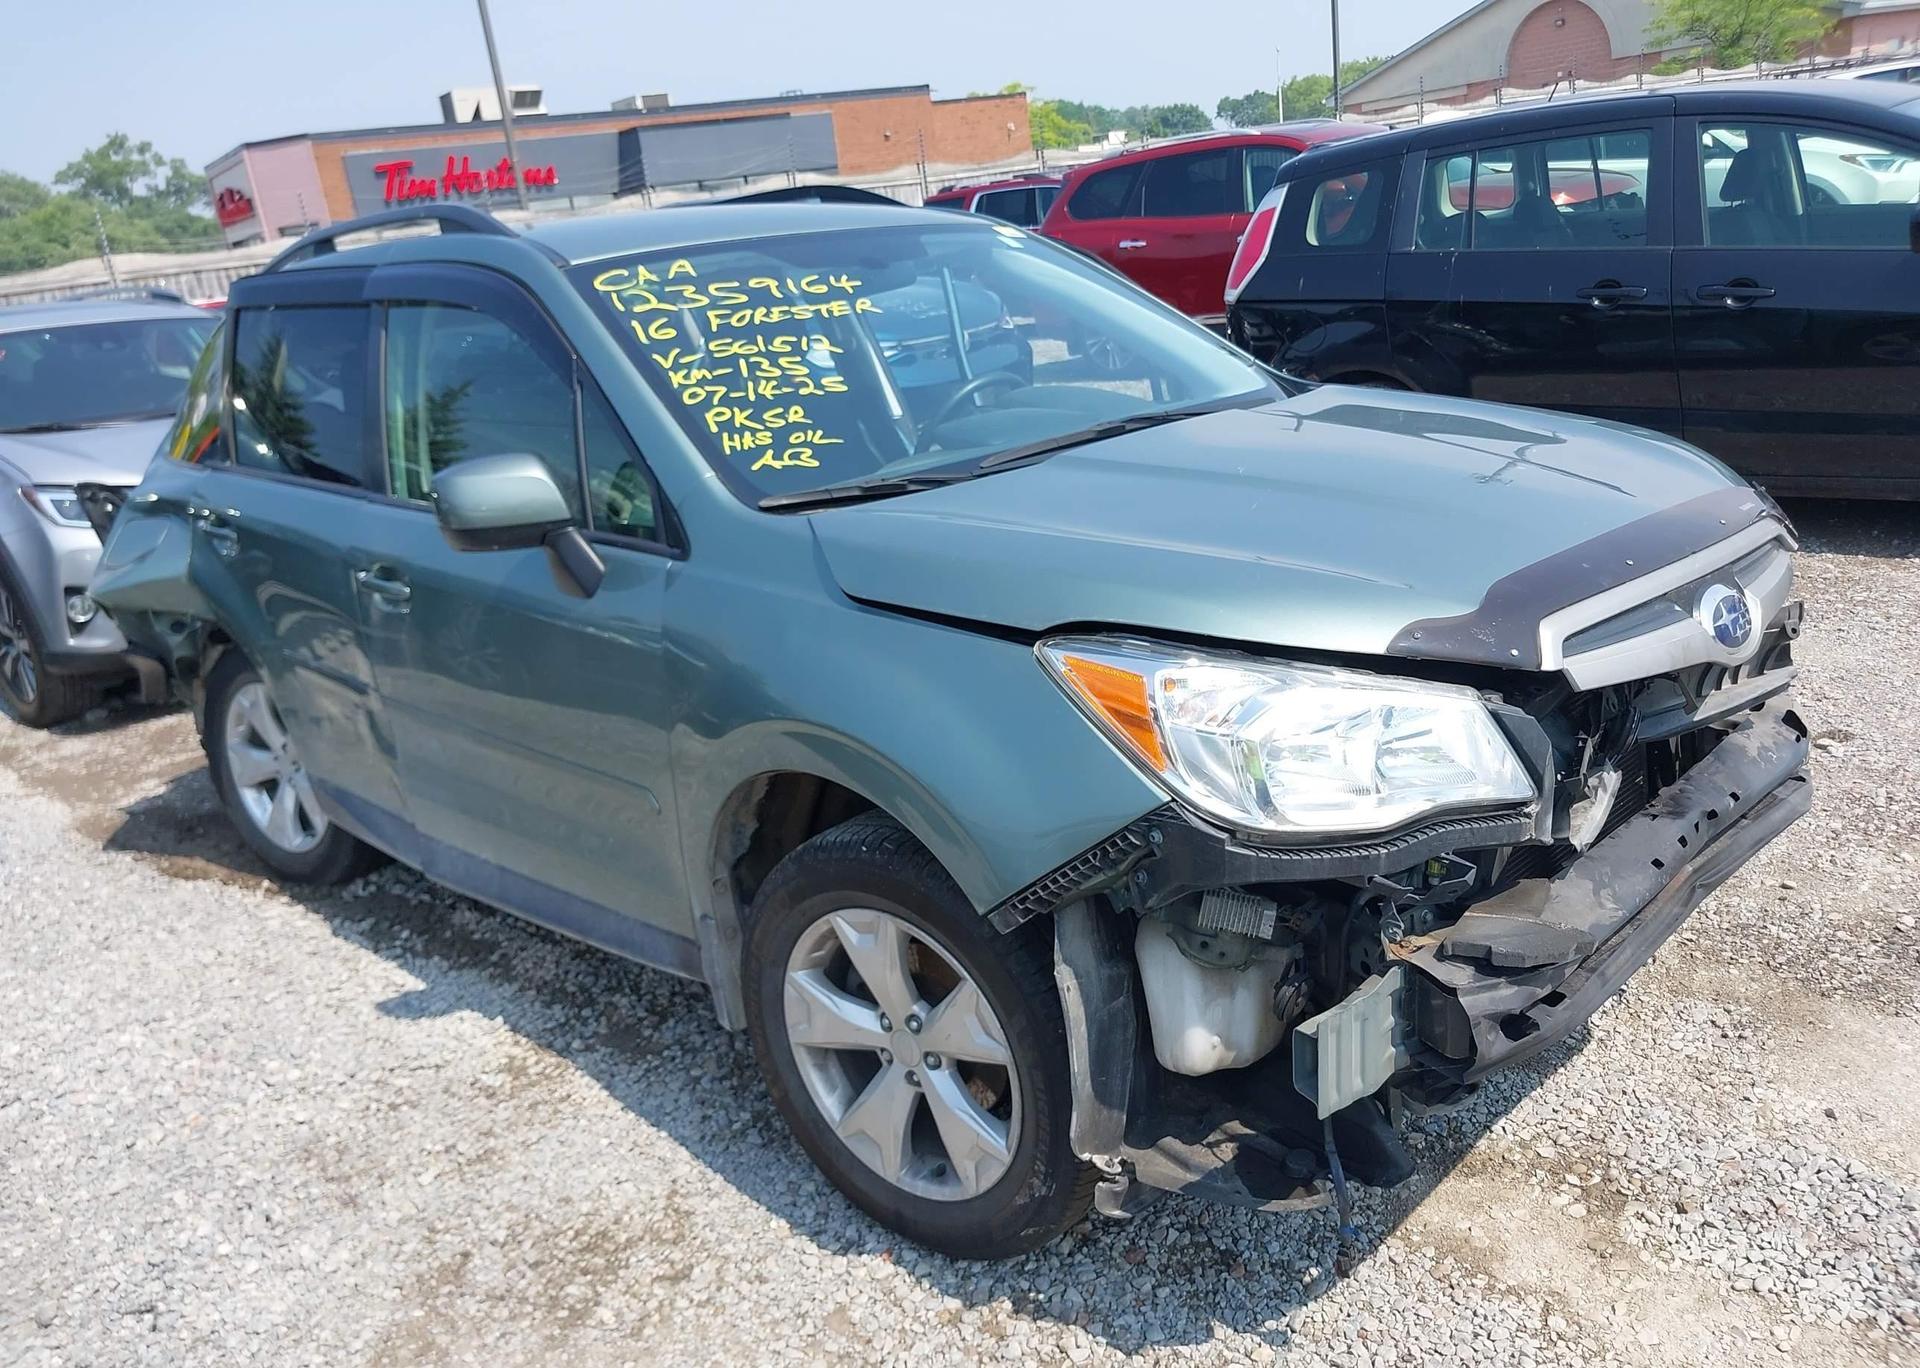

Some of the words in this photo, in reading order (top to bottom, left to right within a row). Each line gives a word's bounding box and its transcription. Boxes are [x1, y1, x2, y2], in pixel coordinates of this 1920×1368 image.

[375, 161, 436, 202] Tim
[593, 259, 697, 291] CAA
[611, 274, 862, 312] 12359164
[632, 318, 677, 344] 16
[706, 297, 883, 332] FORESTER
[682, 376, 848, 405] 07-14-25
[722, 432, 773, 455] HAS
[789, 430, 844, 444] OIL
